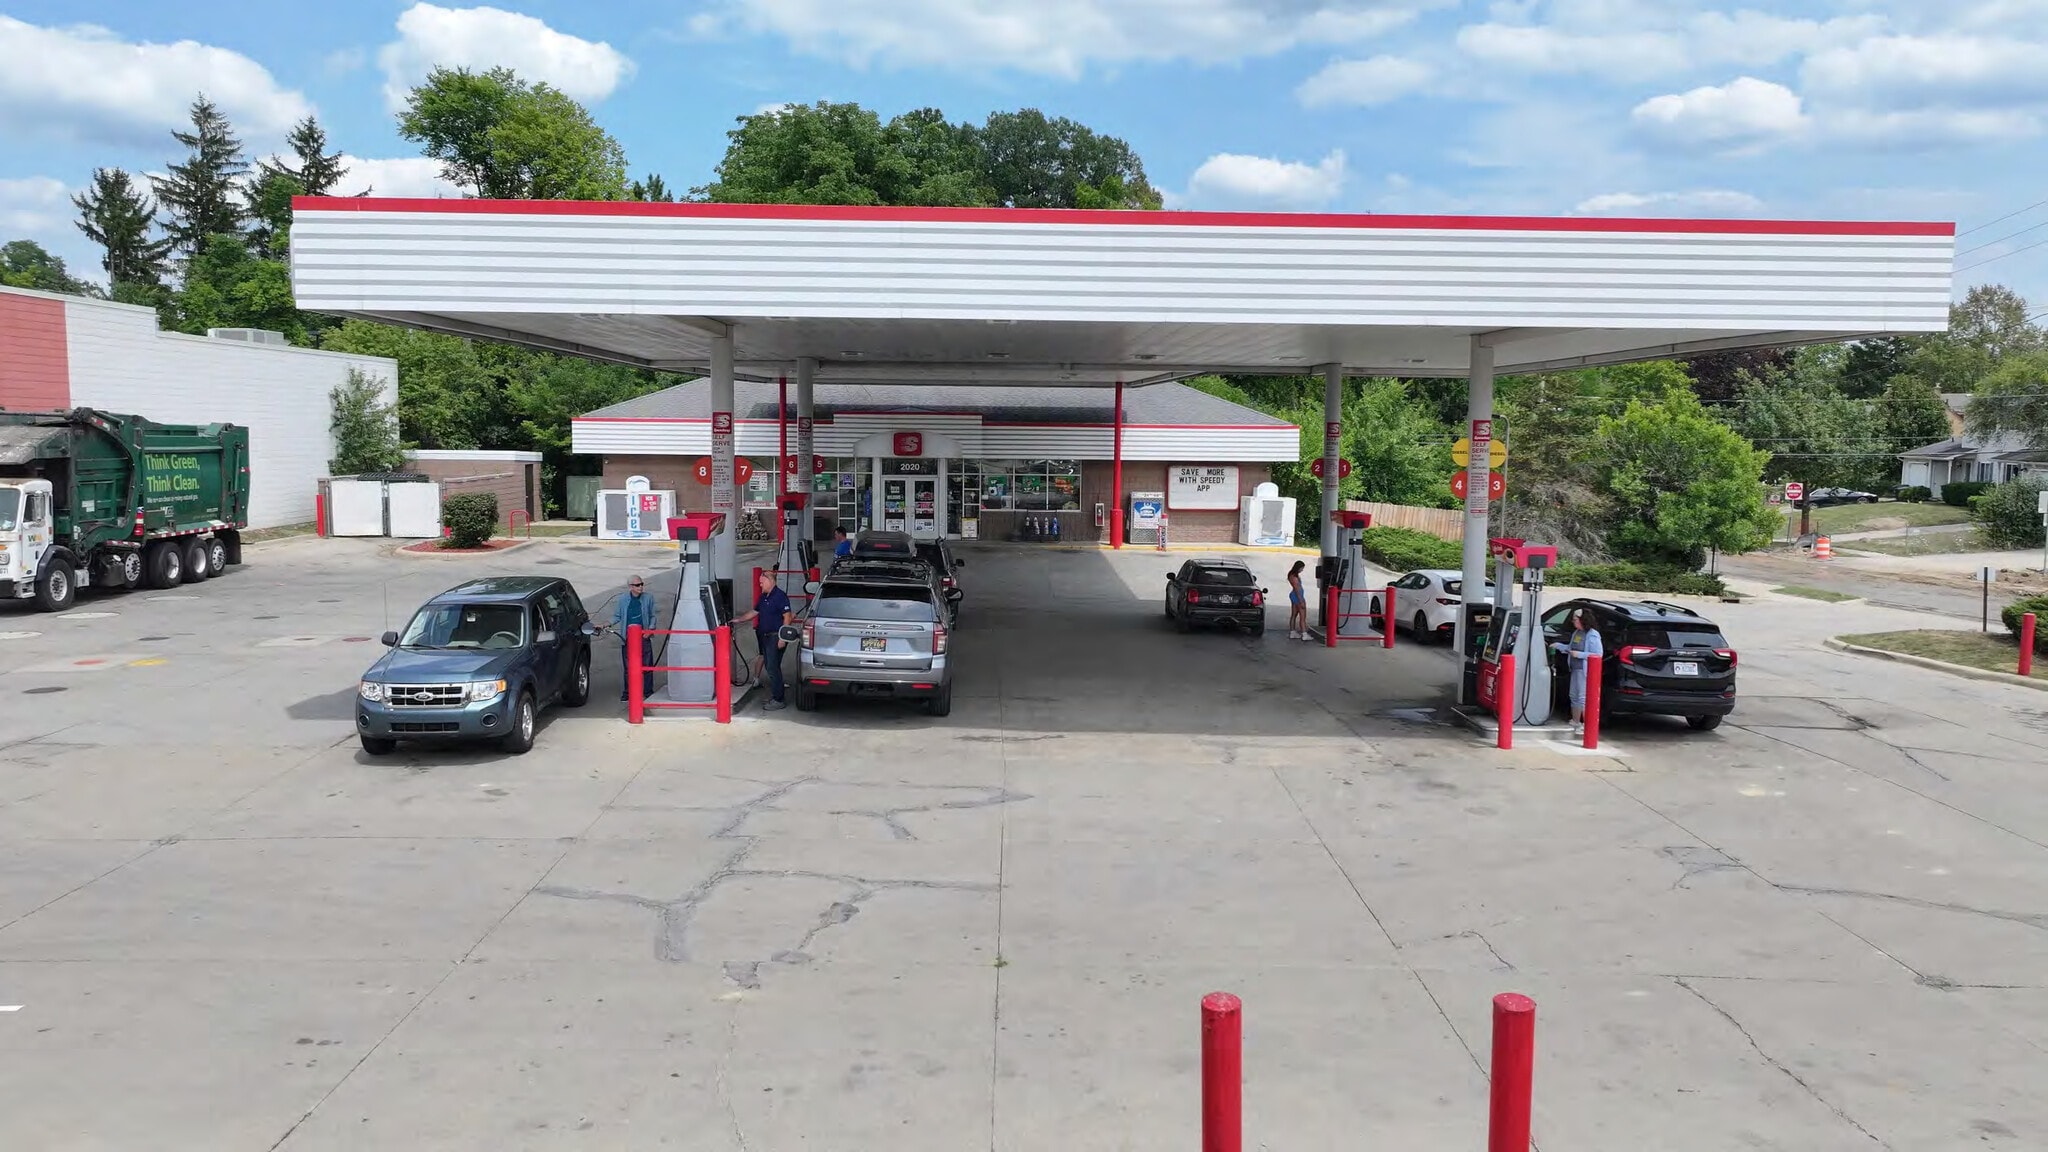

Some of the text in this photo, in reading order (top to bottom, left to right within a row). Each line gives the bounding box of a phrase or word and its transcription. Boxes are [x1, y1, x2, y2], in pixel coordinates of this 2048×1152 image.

[145, 453, 201, 471] Think Green,
[788, 460, 795, 469] 6
[816, 460, 823, 468] 5
[740, 465, 748, 476] 7
[900, 463, 920, 471] 2020
[1314, 464, 1321, 472] 2
[1342, 464, 1347, 472] 1
[699, 466, 707, 477] 8
[1181, 468, 1225, 476] SAVE MORE
[146, 474, 200, 492] Think Clean.
[1179, 476, 1226, 484] WITH SPEEDY
[1197, 484, 1211, 492] APP
[1455, 480, 1463, 490] 4
[1492, 480, 1500, 490] 3
